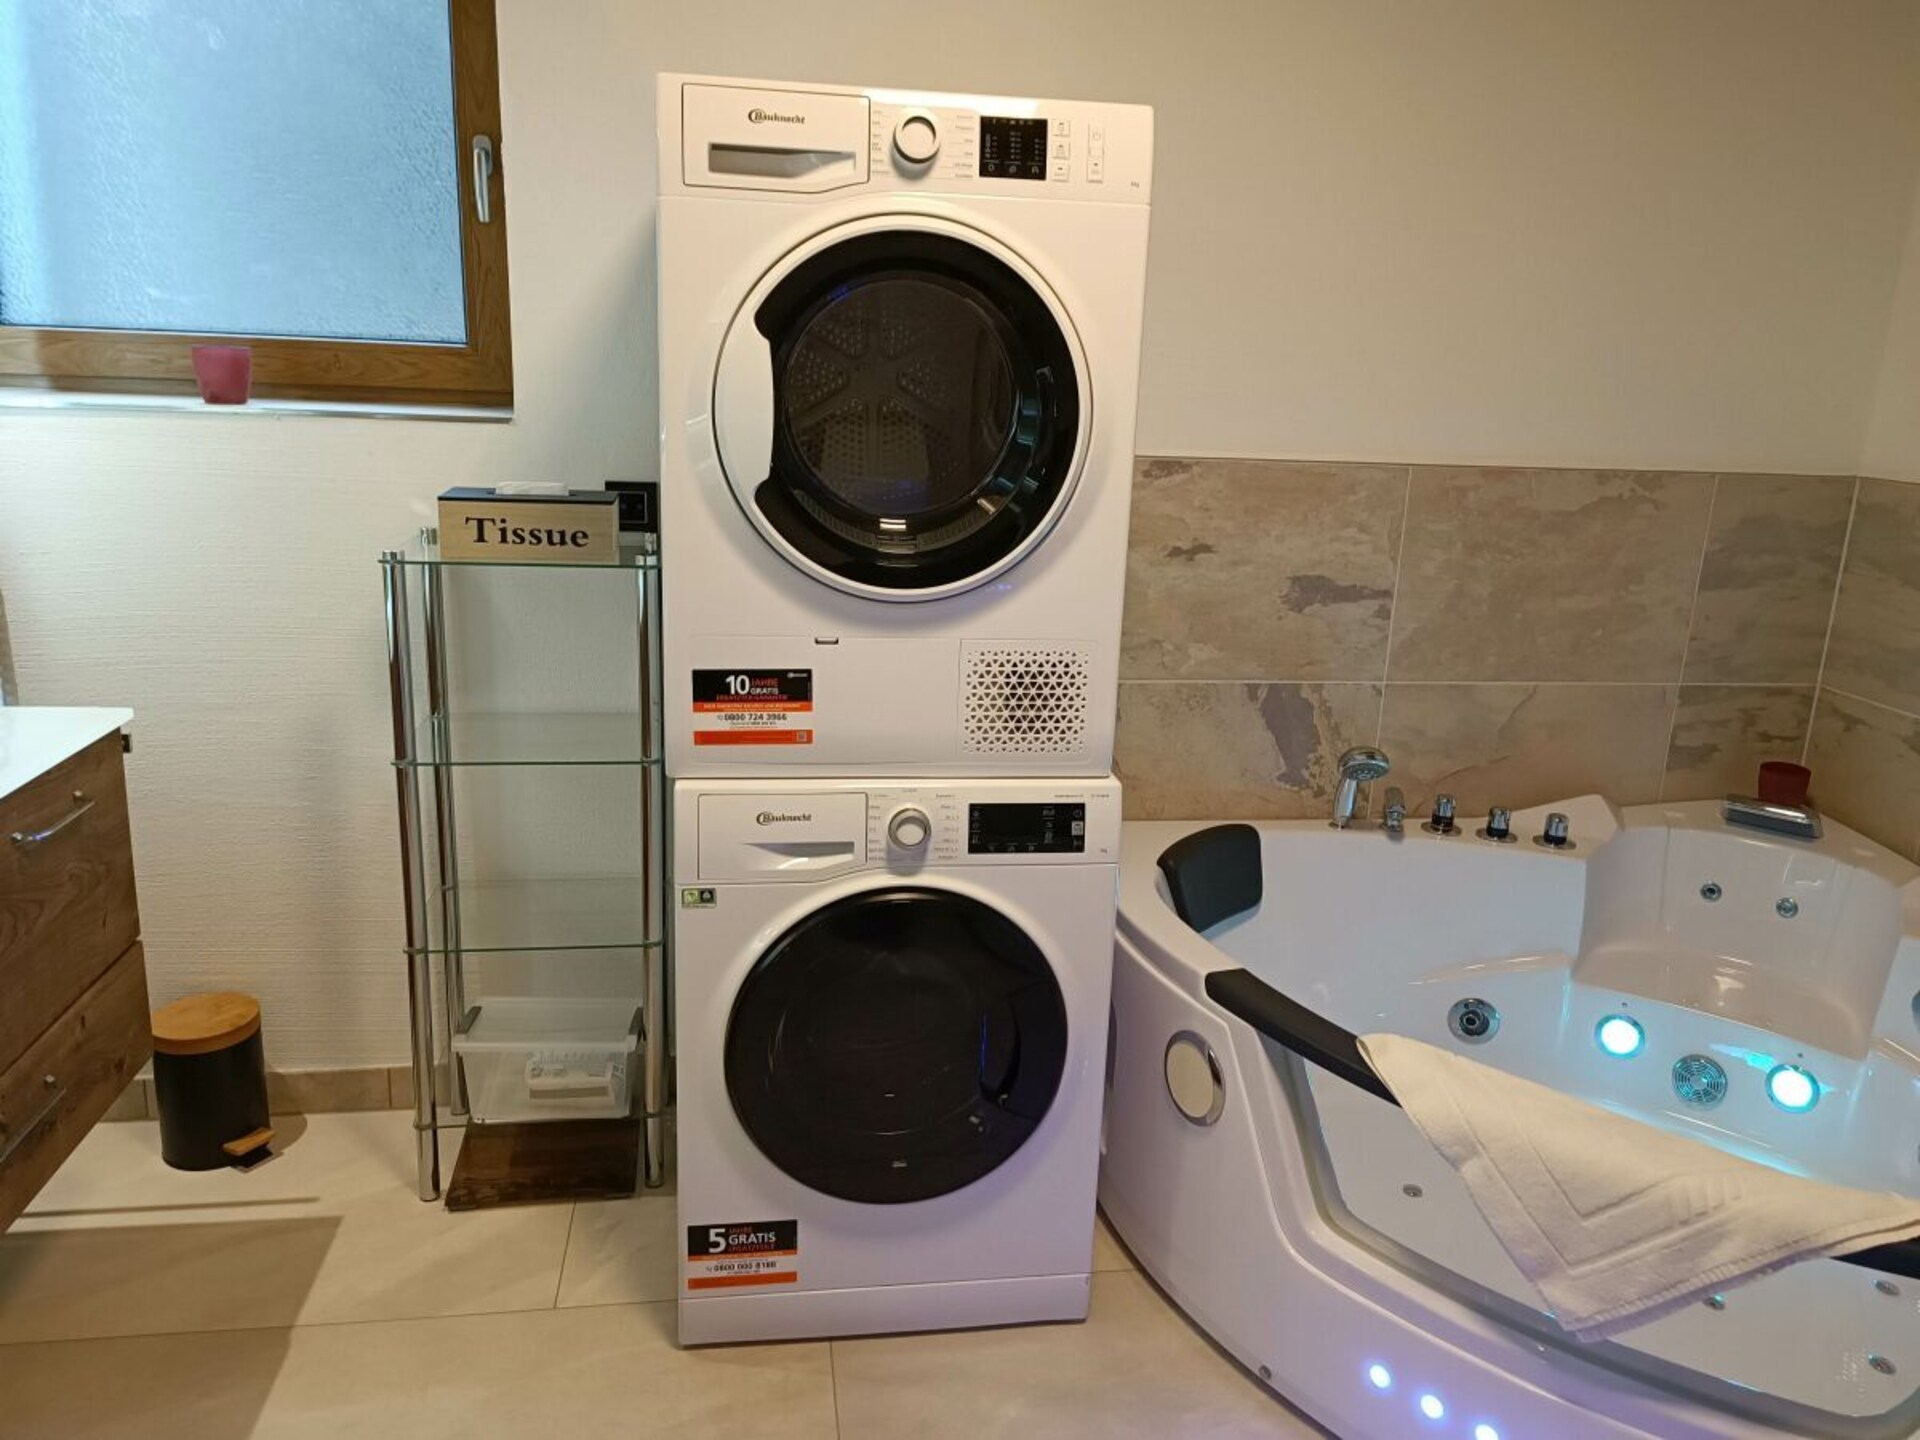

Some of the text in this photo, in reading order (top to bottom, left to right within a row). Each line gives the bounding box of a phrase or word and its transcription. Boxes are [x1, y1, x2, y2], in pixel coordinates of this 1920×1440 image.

[465, 516, 589, 548] Tissue
[725, 674, 750, 695] 10
[750, 687, 779, 695] GRATIS
[708, 1228, 726, 1254] 5
[728, 1231, 777, 1246] GRATIS
